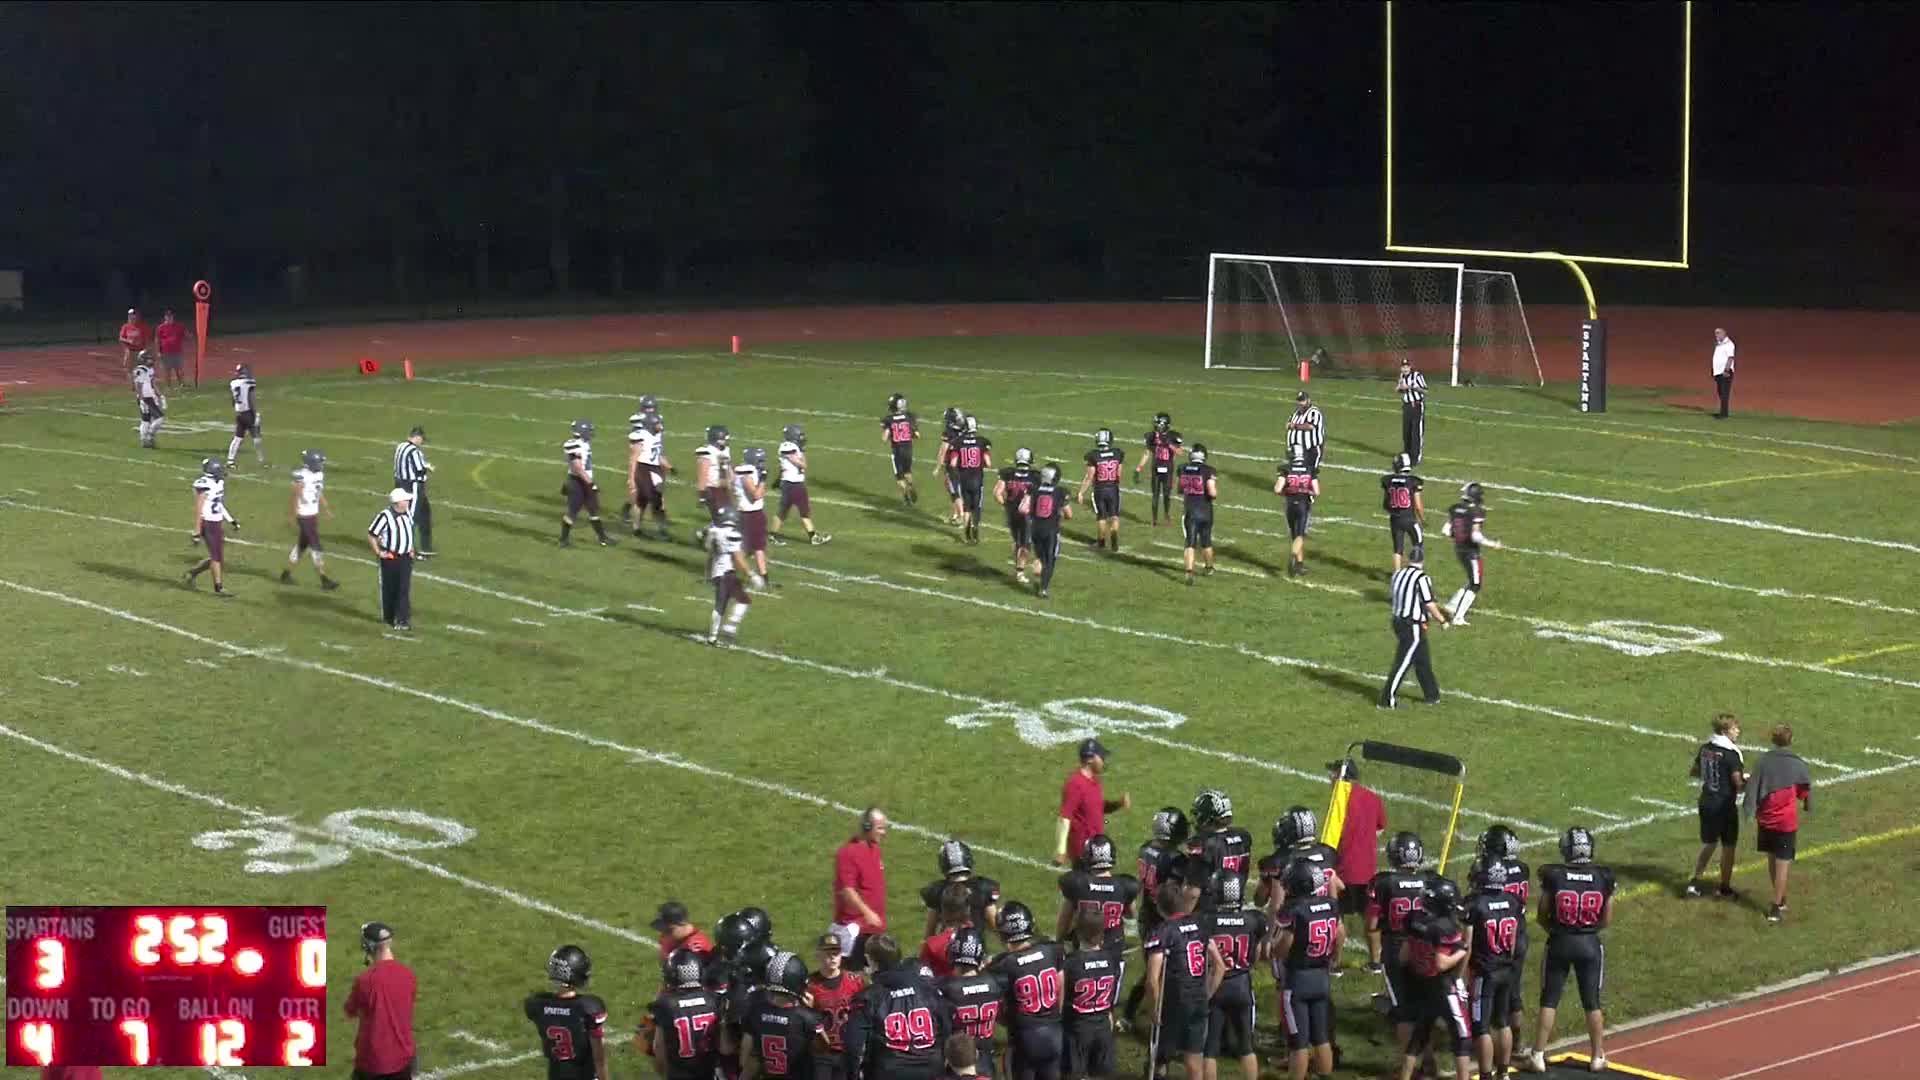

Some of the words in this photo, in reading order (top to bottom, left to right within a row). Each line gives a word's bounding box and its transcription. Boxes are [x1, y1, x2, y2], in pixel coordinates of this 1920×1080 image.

[960, 447, 981, 467] 19
[945, 698, 1187, 750] 20
[191, 806, 478, 873] 30
[1555, 890, 1603, 926] 88
[1306, 917, 1337, 957] 51
[1186, 940, 1205, 977] 6
[1015, 967, 1058, 1014] 90
[1073, 975, 1116, 1014] 22
[674, 1012, 718, 1058] 17
[884, 1007, 935, 1052] 99
[762, 1034, 788, 1074] 5
